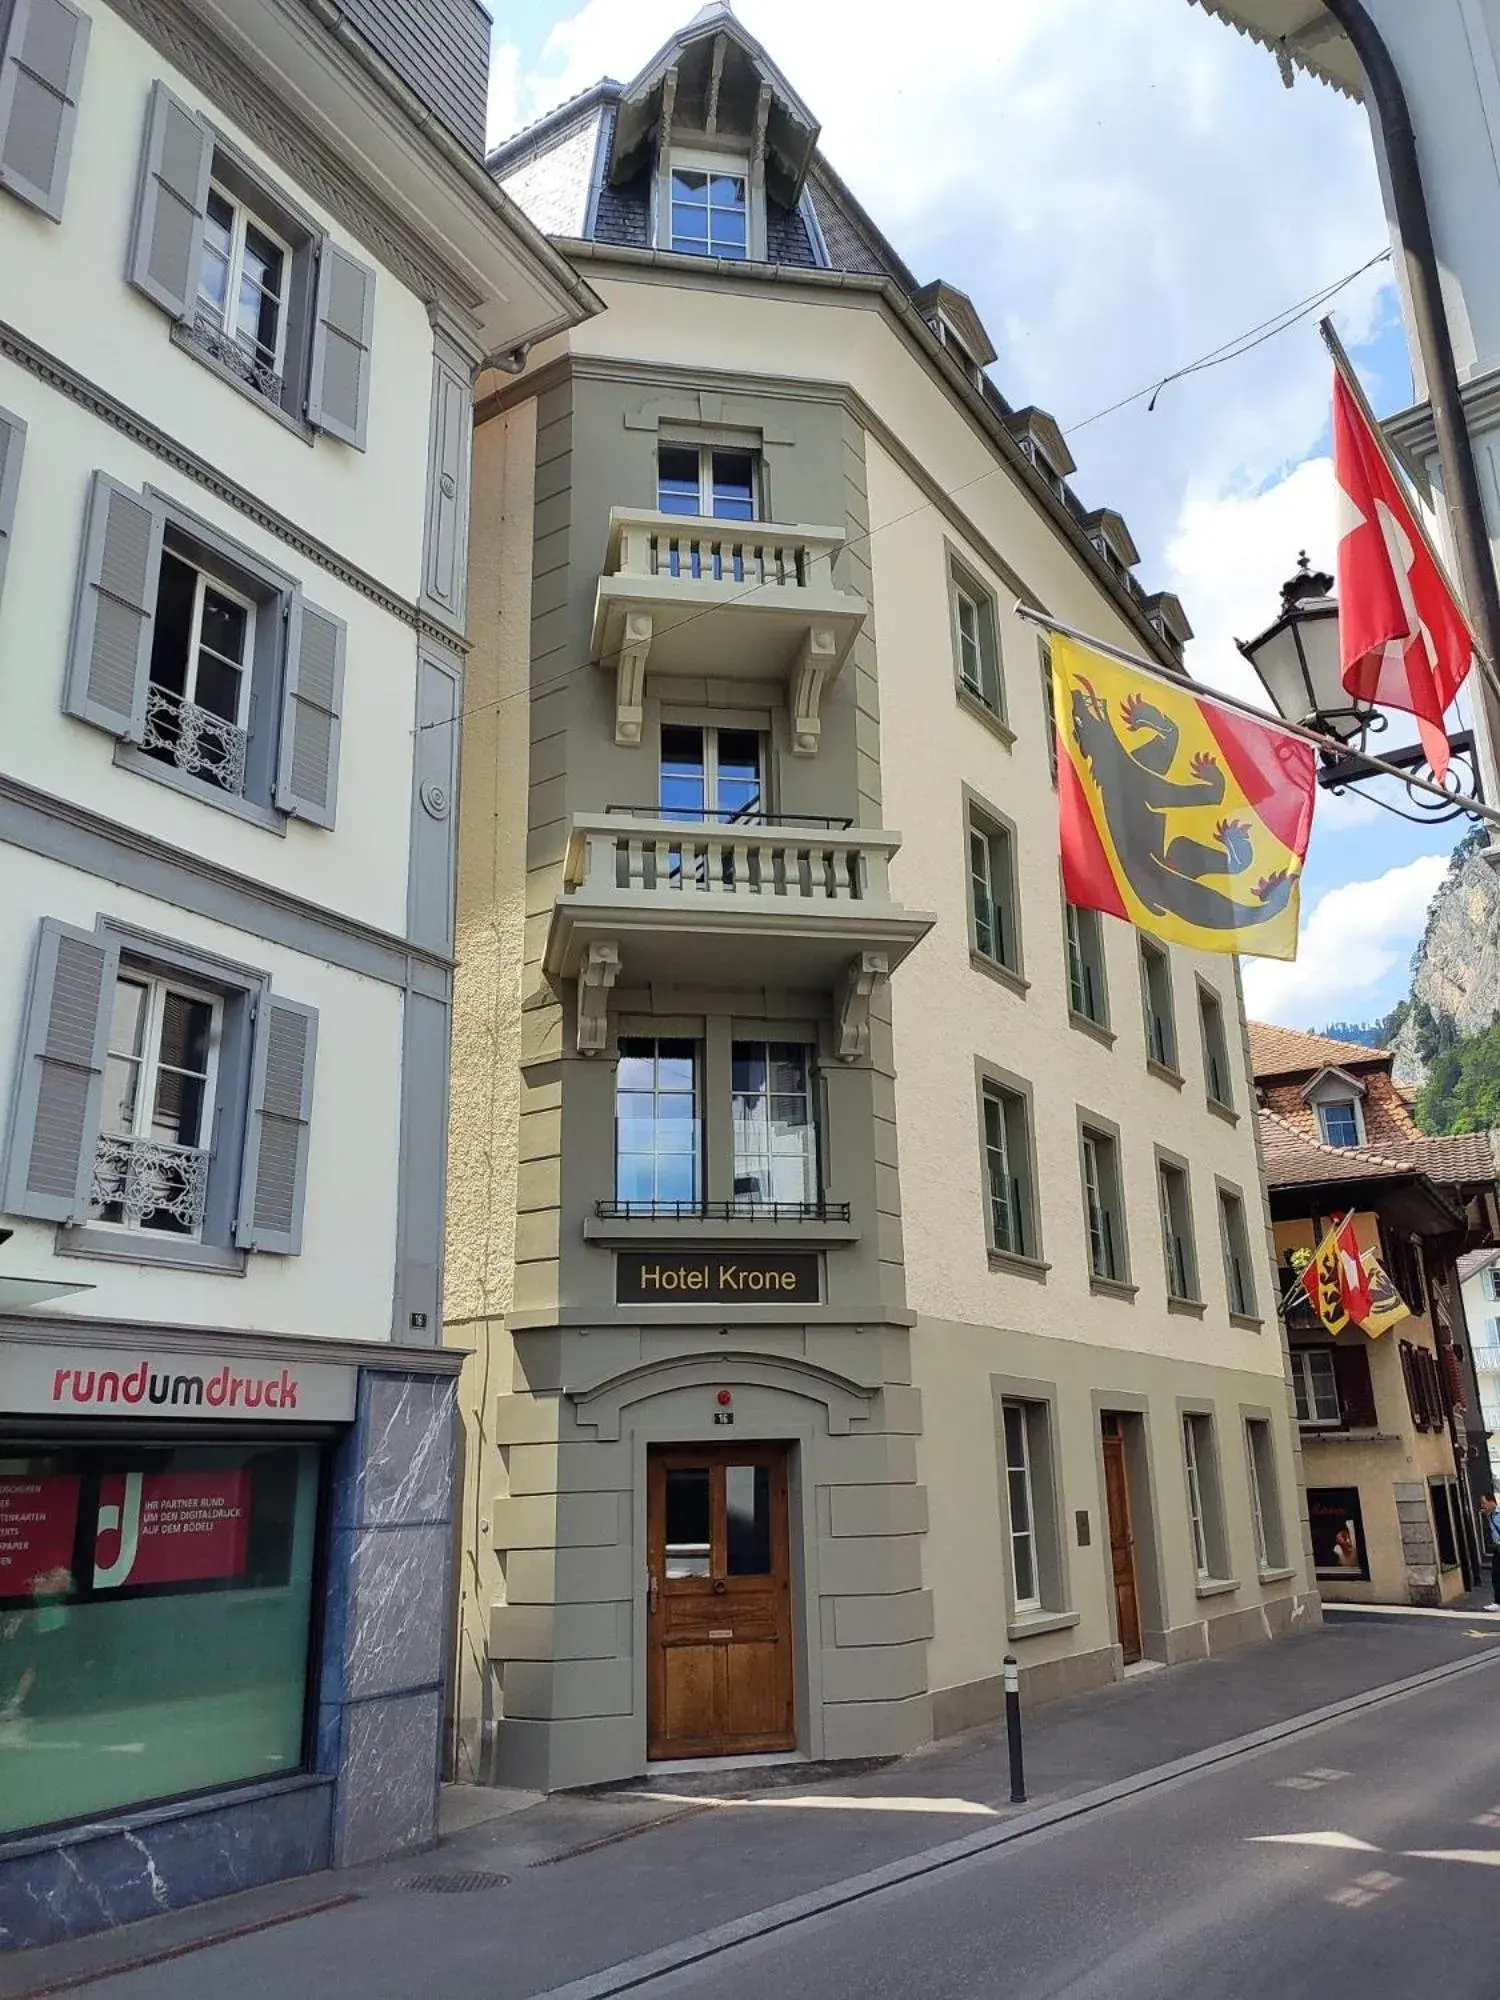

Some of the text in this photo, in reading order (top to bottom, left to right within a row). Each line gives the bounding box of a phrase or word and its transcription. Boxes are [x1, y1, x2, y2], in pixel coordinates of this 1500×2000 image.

[641, 1265, 797, 1290] Hotel Krone
[52, 1361, 298, 1409] rundumdruck
[144, 1496, 225, 1510] IHR PARTNER RUND
[143, 1508, 242, 1523] UM DEN DIGITALDRUCK
[142, 1524, 160, 1535] AUF
[161, 1522, 181, 1534] DEM
